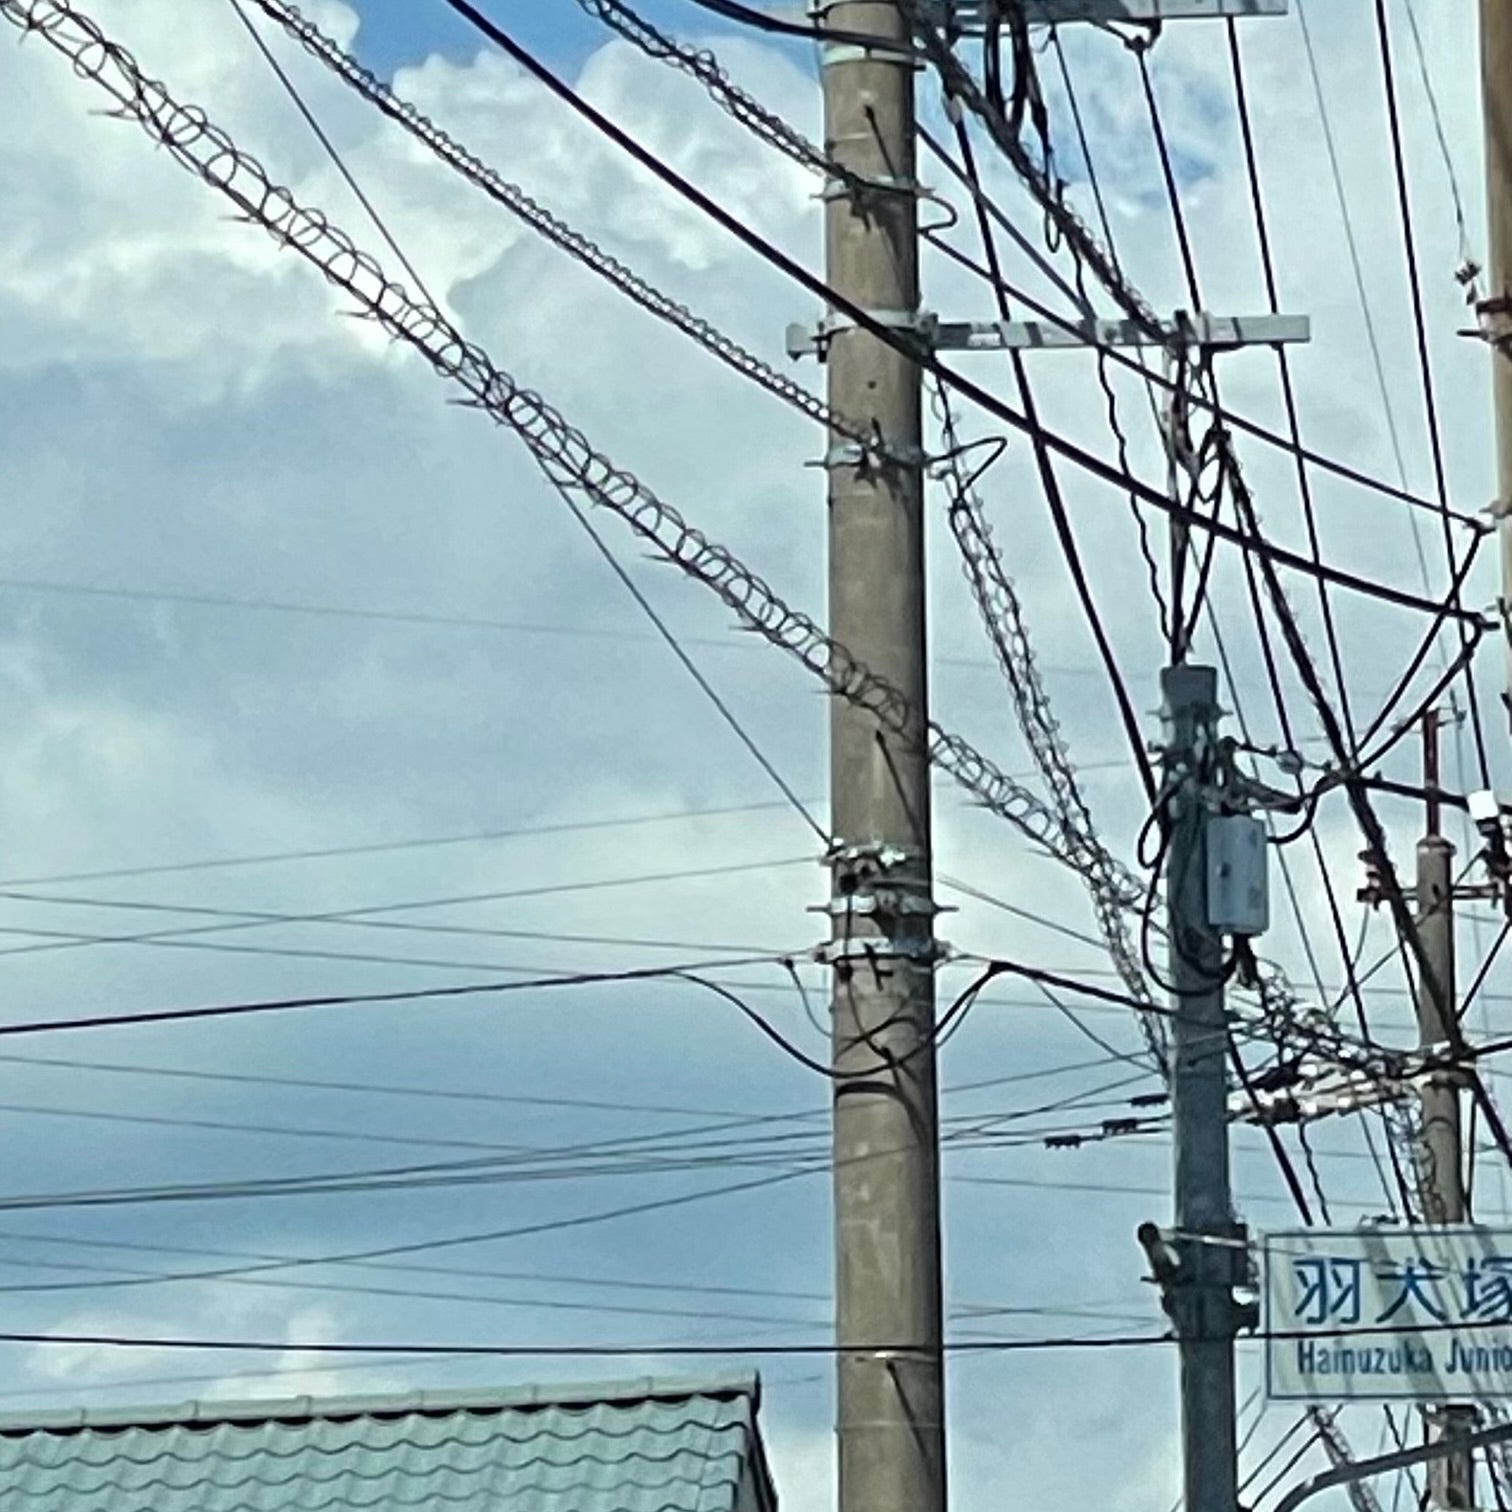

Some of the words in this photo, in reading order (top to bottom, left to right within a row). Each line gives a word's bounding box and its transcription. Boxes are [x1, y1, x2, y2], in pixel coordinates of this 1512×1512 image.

[1292, 1256, 1512, 1324] 羽犬塚
[1298, 1340, 1433, 1374] Hainuzuka
